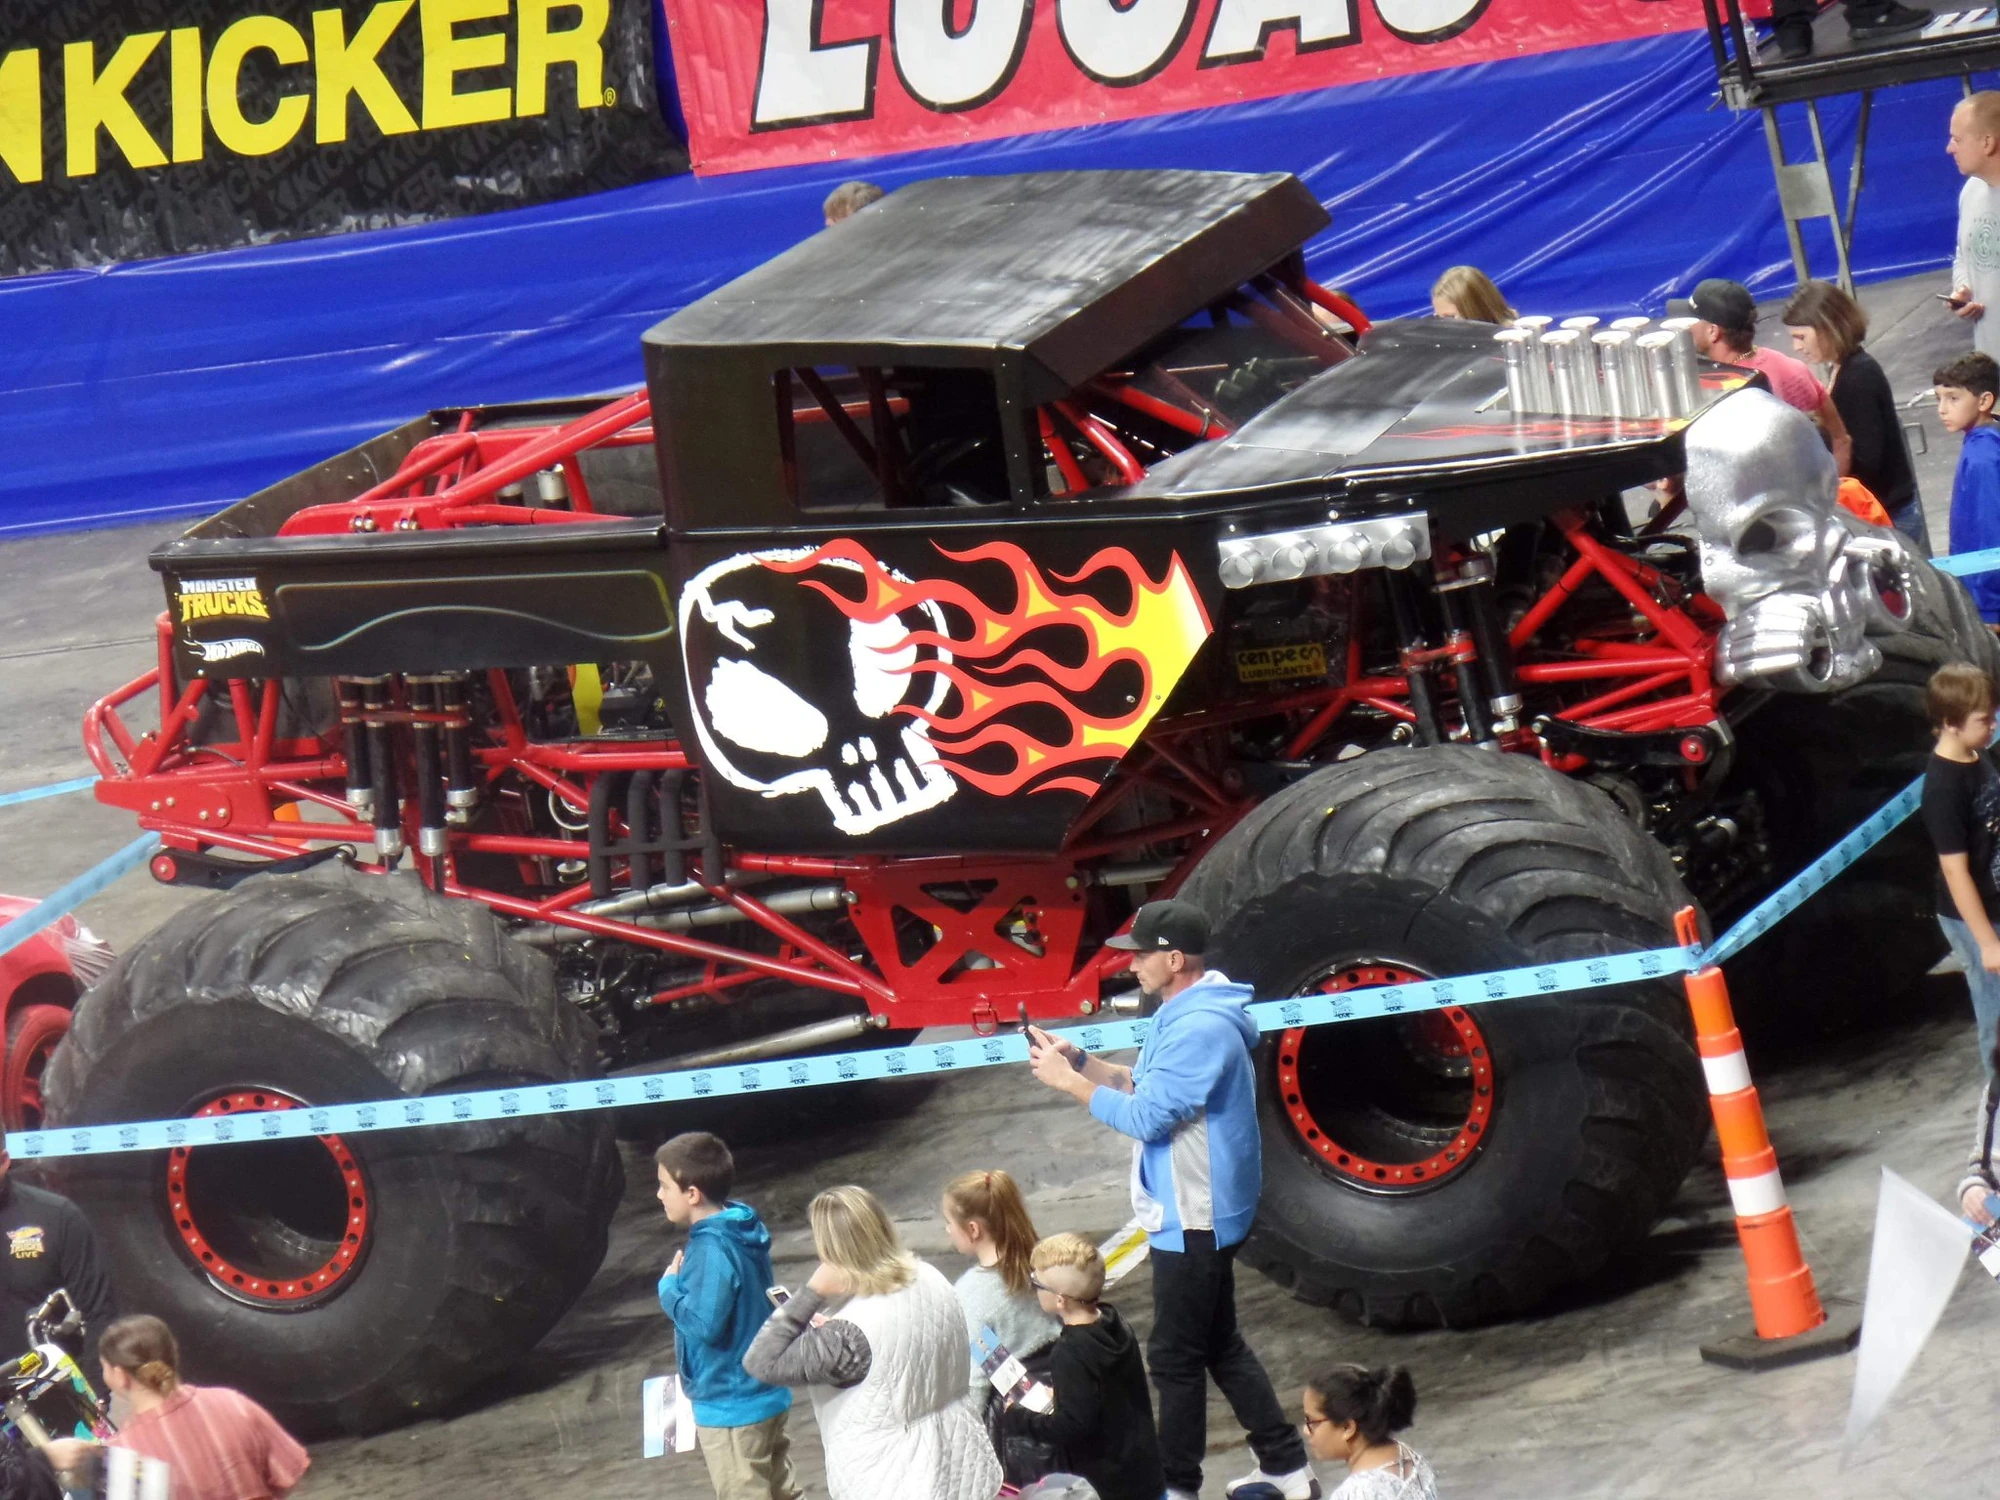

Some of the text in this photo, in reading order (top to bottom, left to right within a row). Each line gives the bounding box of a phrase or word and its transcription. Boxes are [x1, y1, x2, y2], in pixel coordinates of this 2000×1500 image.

[749, 0, 1494, 133] LUC
[63, 0, 606, 178] KICKER
[179, 577, 258, 594] MONSTER
[178, 590, 271, 623] TRUCKS
[1241, 663, 1313, 680] LUBRICANTS
[16, 1251, 38, 1259] LIVE
